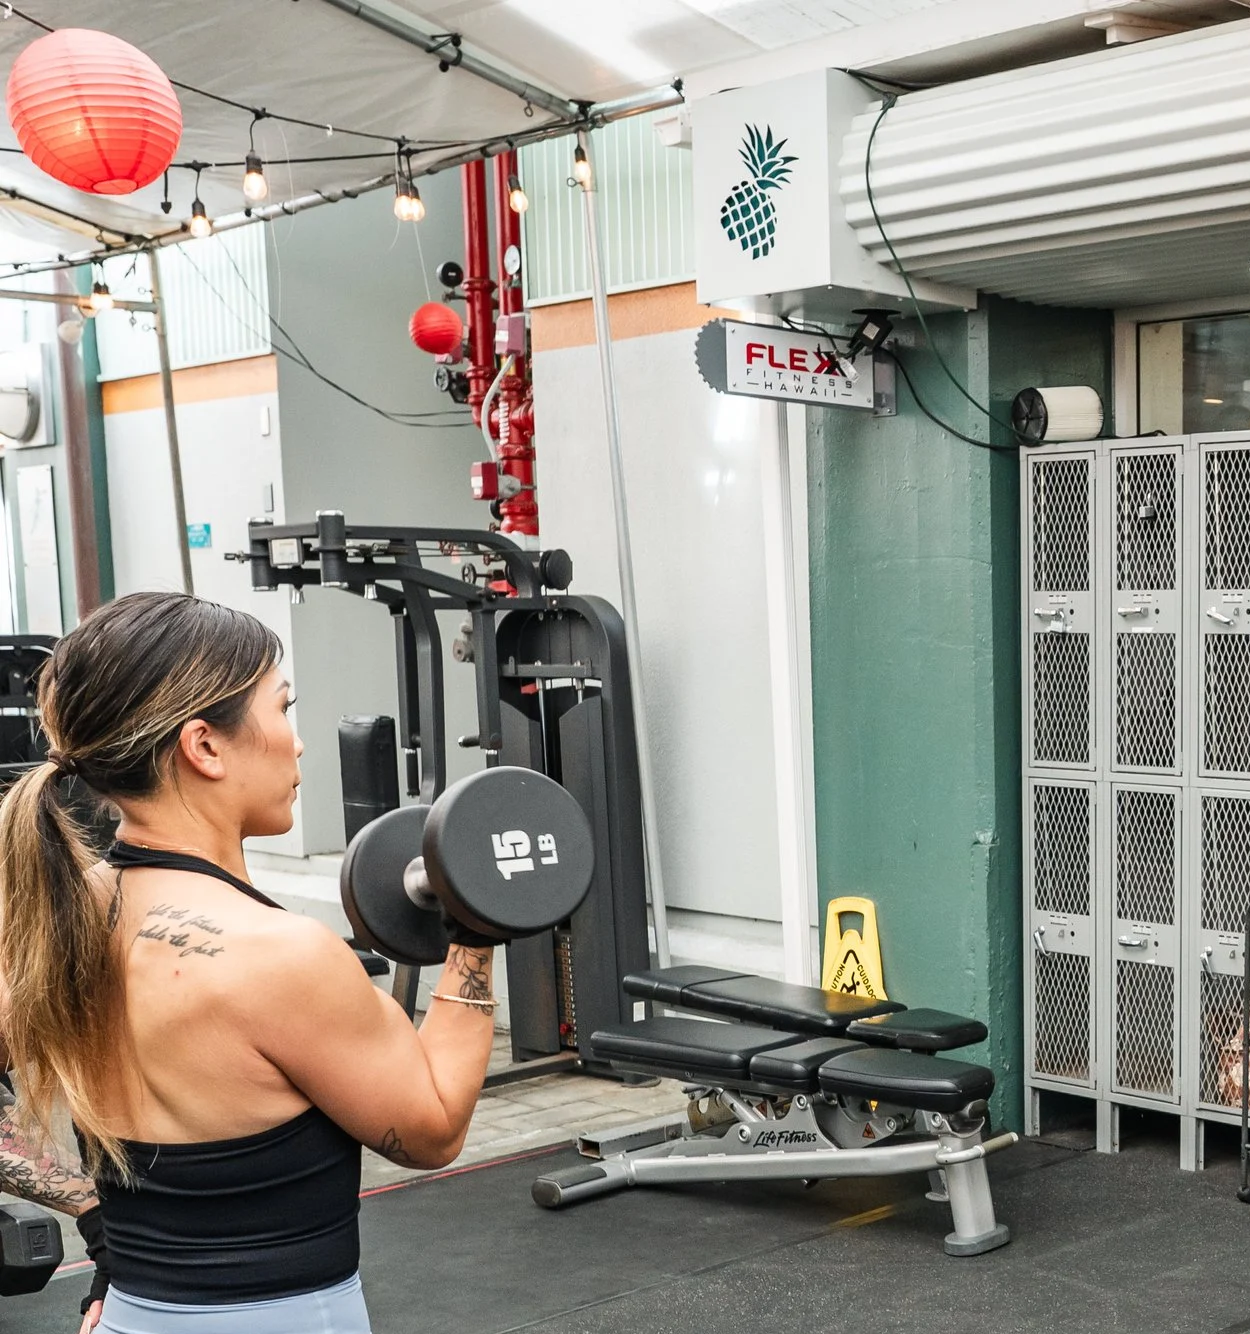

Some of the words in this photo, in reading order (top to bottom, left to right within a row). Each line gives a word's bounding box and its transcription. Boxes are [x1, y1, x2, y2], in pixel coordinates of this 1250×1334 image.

[746, 368, 853, 390] FITNESS
[764, 381, 837, 398] HAWAII
[491, 829, 535, 880] 15
[537, 833, 559, 865] LB
[831, 963, 846, 990] UTION
